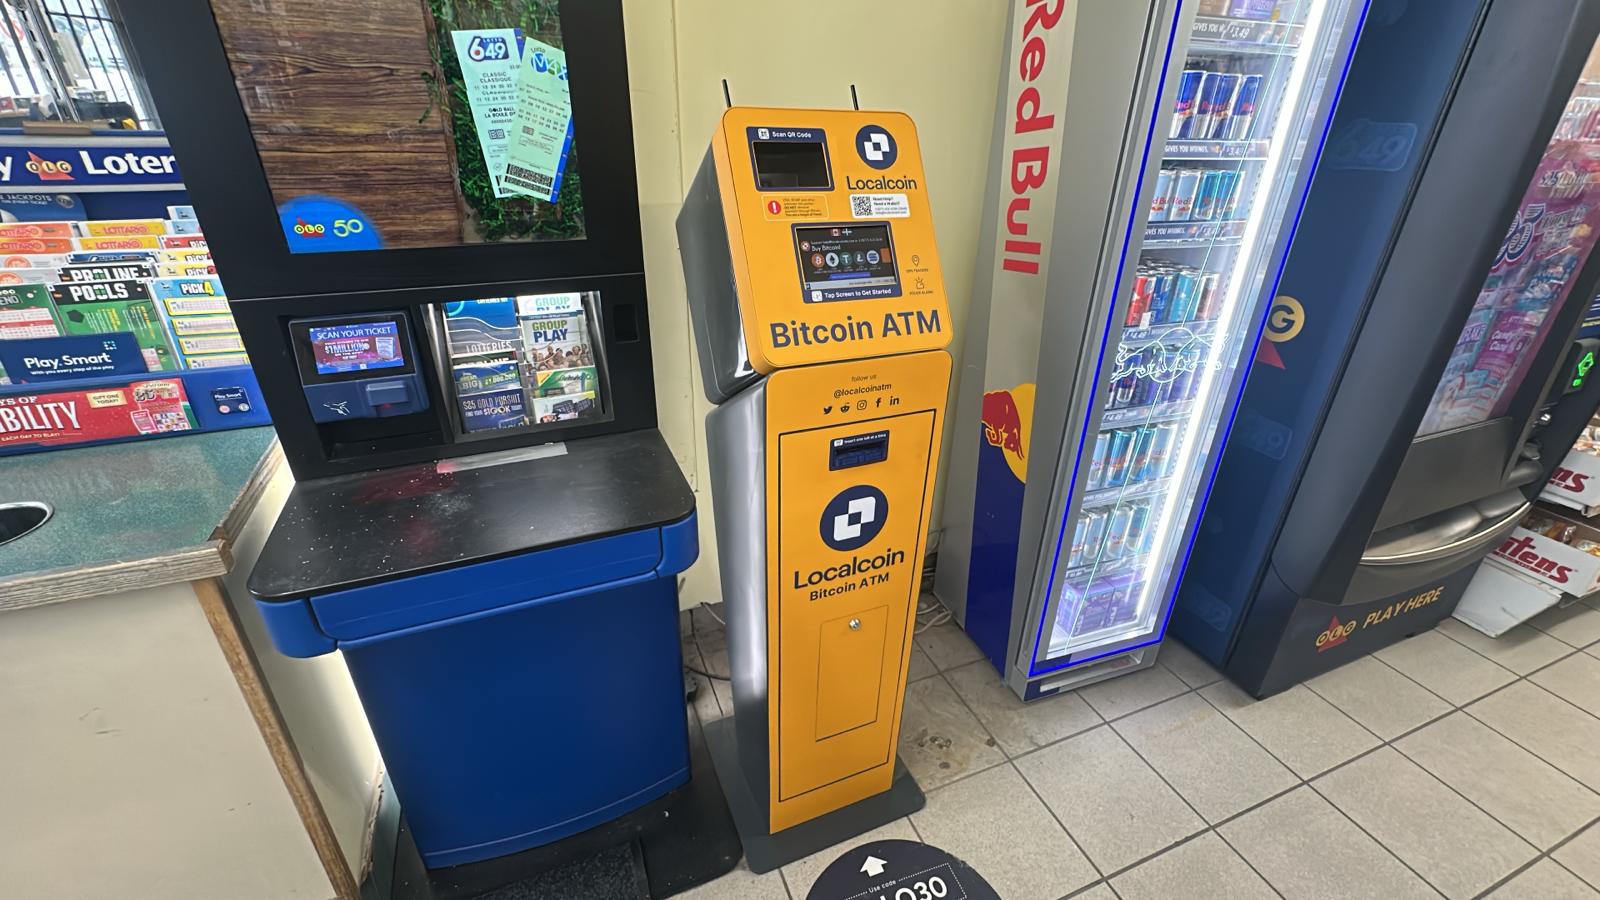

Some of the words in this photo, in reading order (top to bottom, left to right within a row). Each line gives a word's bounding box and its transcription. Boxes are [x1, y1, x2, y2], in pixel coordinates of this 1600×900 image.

[846, 175, 918, 191] Localcoin
[1003, 146, 1050, 275] Bull
[332, 218, 364, 237] 50
[68, 283, 129, 302] POOLS
[535, 296, 571, 308] GROUP
[531, 319, 568, 331] GROUP
[769, 315, 874, 349] Bitcoin
[881, 308, 942, 339] ATM
[316, 331, 340, 340] SCAN
[340, 329, 364, 338] YOUR
[364, 326, 392, 336] TICKET
[533, 328, 568, 343] PLAY
[462, 380, 478, 389] BIG
[850, 374, 868, 382] follow
[833, 383, 893, 398] @localcoinatm
[18, 396, 38, 405] OF
[793, 548, 905, 590] Localcoin
[809, 582, 856, 602] Bitcoin
[859, 572, 890, 590] ATM
[1362, 600, 1406, 629] PLAY
[1404, 586, 1445, 613] HERE
[867, 885, 881, 894] Use
[881, 879, 897, 889] code
